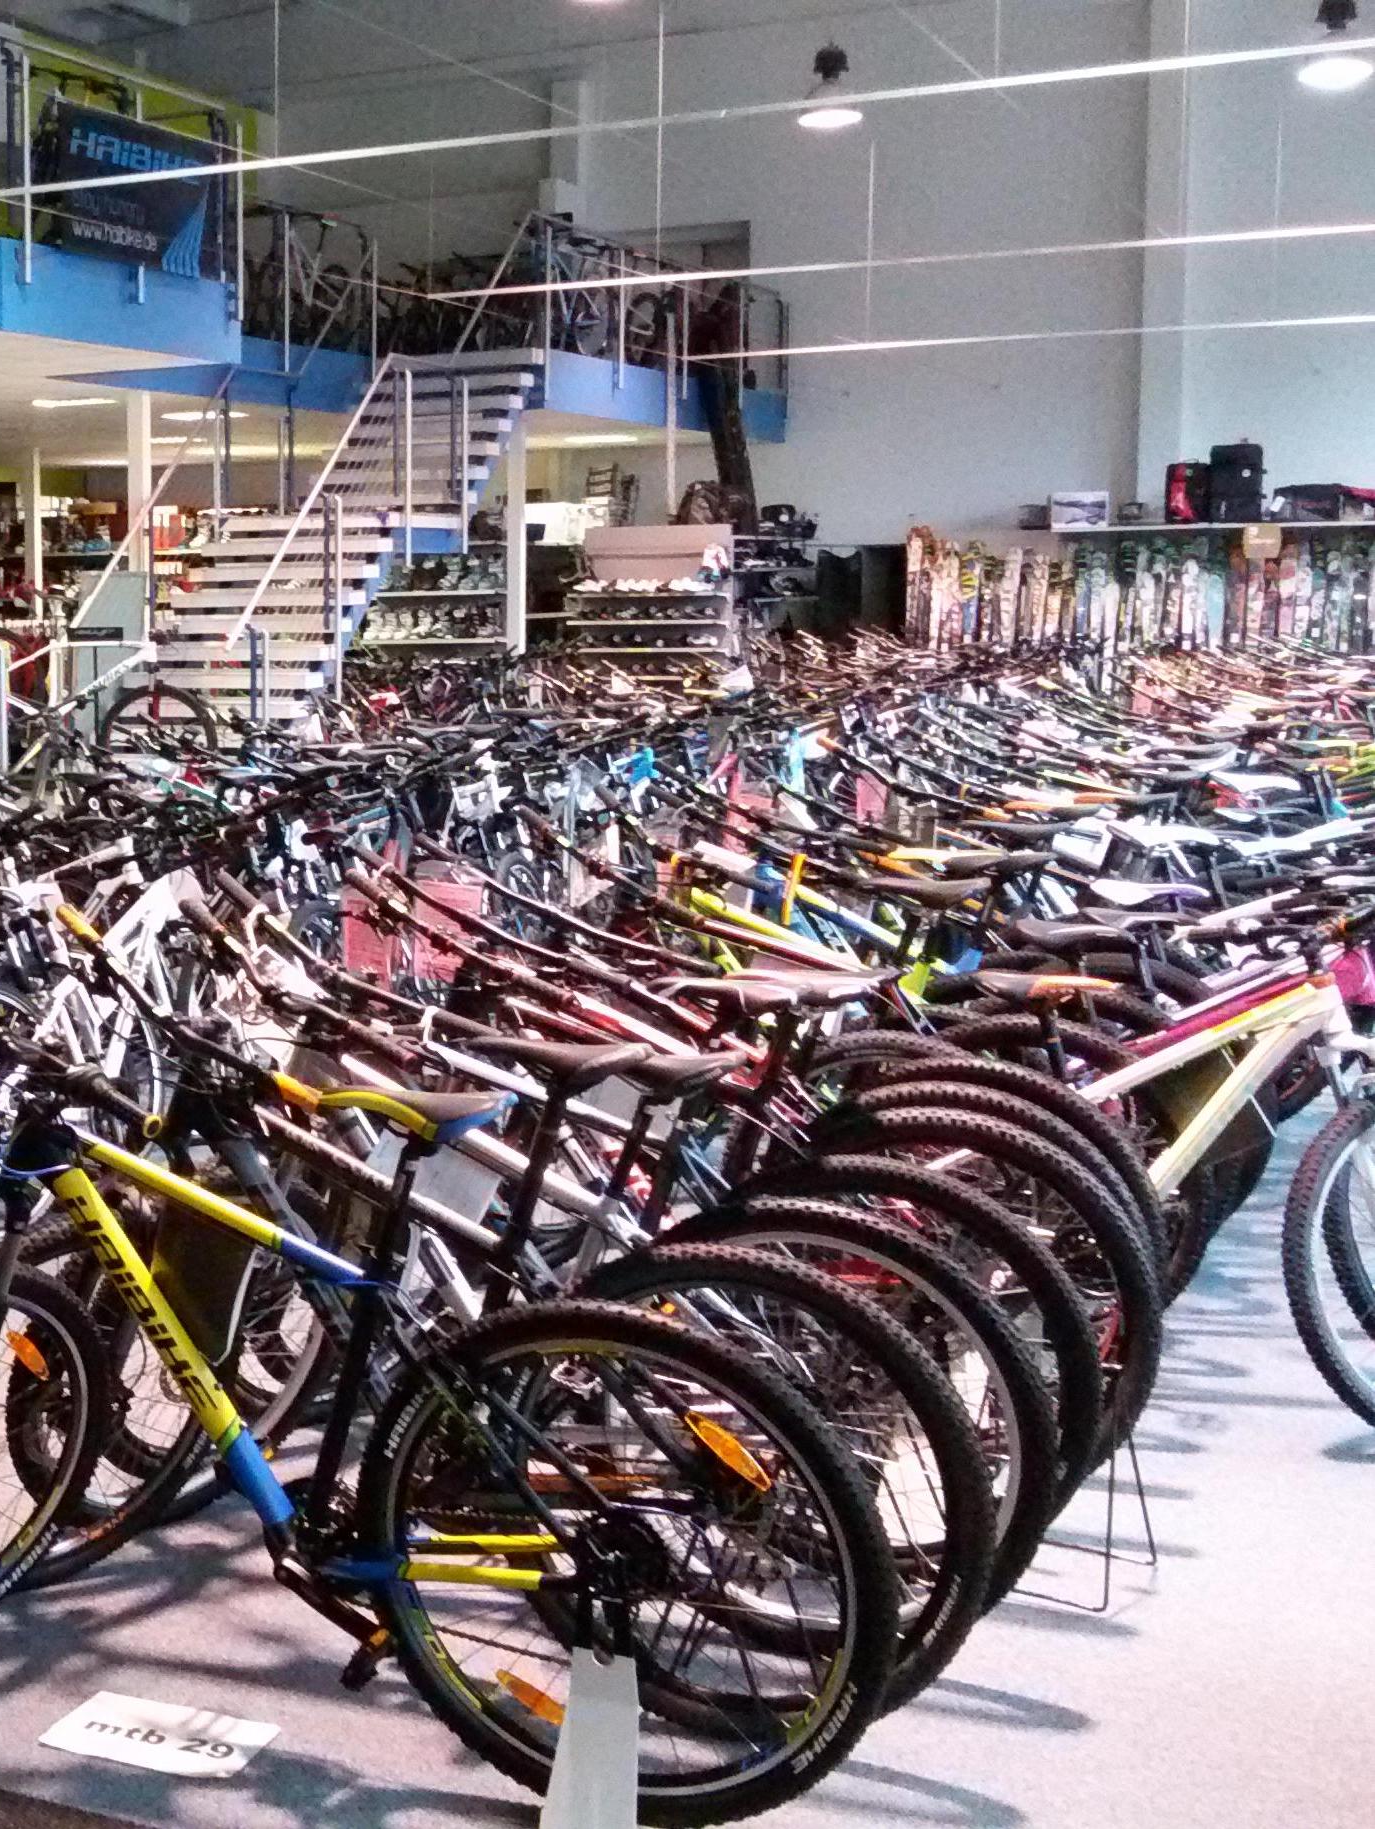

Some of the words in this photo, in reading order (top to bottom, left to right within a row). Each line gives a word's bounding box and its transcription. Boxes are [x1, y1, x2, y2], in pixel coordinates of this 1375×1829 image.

[68, 1195, 219, 1412] HAIBIKE
[84, 1720, 166, 1745] mtb
[178, 1736, 234, 1759] 29
